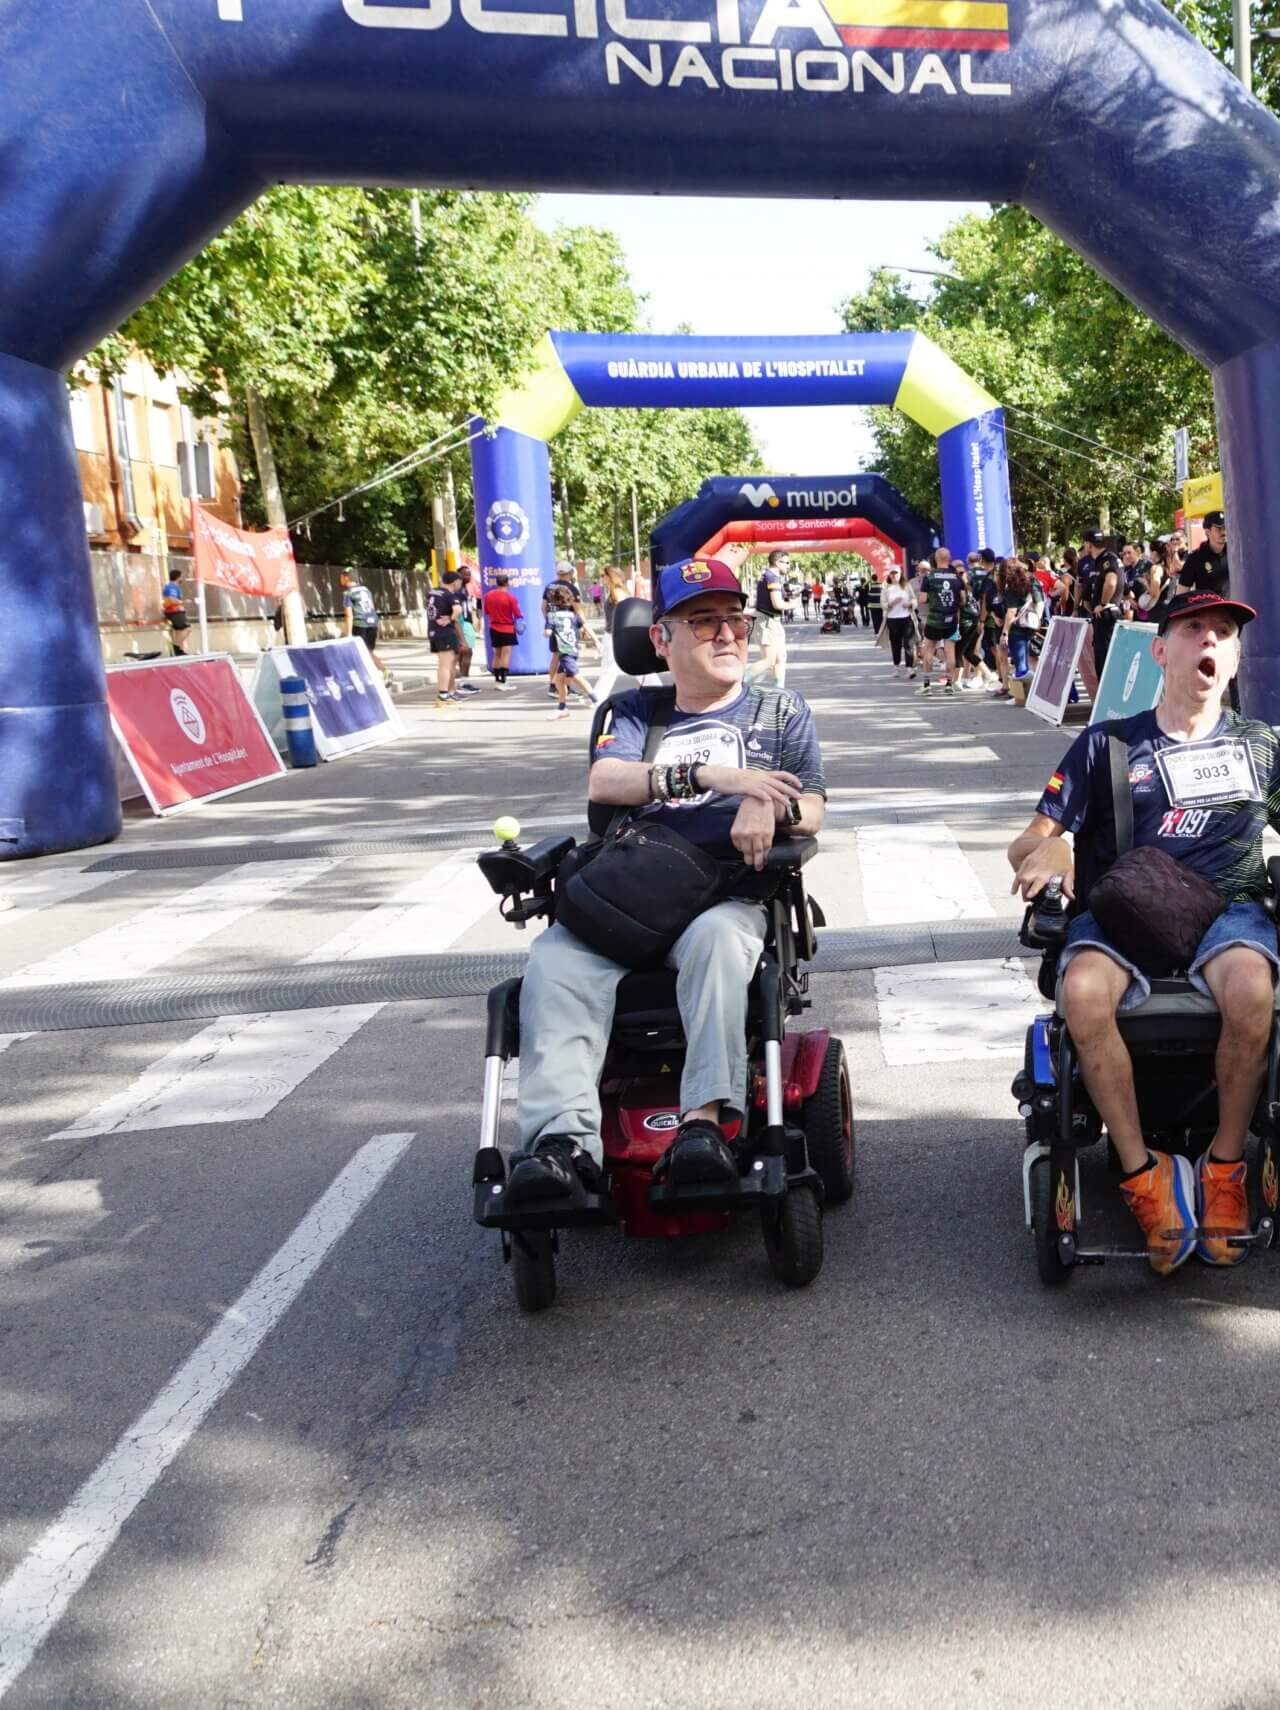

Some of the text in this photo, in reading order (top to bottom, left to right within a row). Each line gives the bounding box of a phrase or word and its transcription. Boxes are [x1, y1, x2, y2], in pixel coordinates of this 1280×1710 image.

[605, 41, 1011, 96] NACIONAL
[607, 358, 866, 378] GUÀRDIA URBANA DE L'HOSPITALET
[787, 484, 857, 511] mupol
[798, 518, 849, 529] Santander
[1193, 764, 1230, 780] 3033
